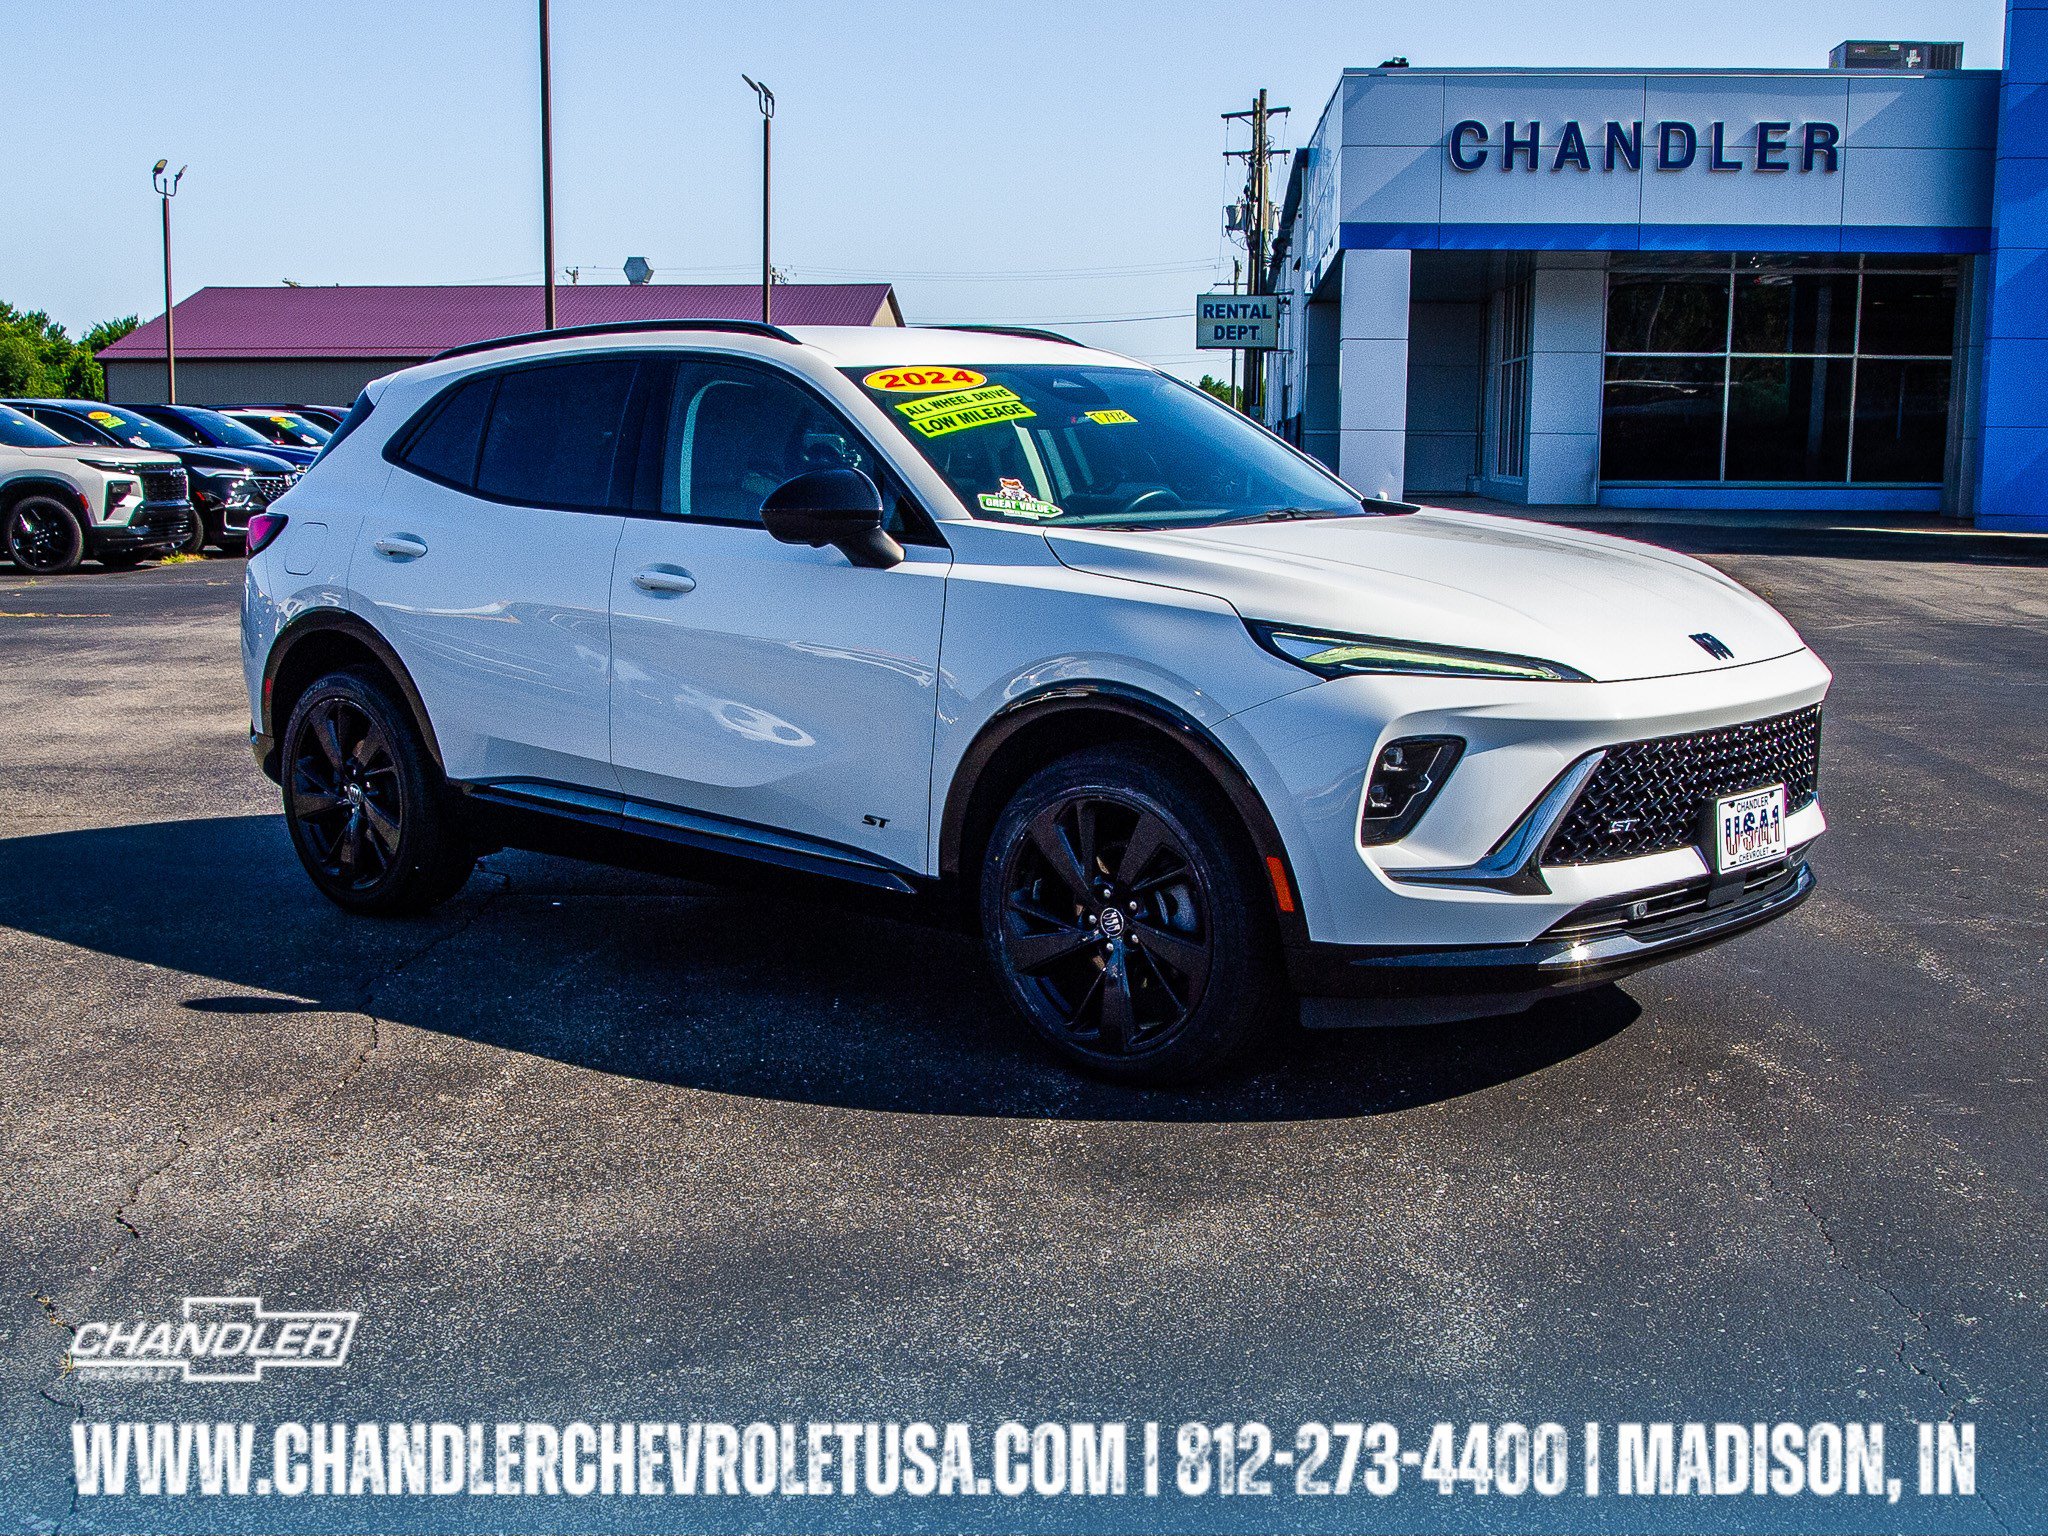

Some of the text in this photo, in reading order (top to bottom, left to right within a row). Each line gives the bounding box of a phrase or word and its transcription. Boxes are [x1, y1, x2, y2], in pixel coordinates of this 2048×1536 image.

[1449, 119, 1841, 173] CHANDLER
[1203, 303, 1272, 319] RENTAL
[1213, 324, 1261, 341] DEPT.
[879, 371, 974, 389] 2024
[905, 388, 1012, 416] ALL WHEEL DRIVE
[918, 403, 1027, 434] LOW MILEAGE
[985, 498, 1018, 510] GREAT
[1019, 502, 1050, 514] VALUE
[1736, 796, 1769, 813] CHANDLER
[862, 814, 891, 829] ST
[1738, 846, 1769, 862] CHEVROLET
